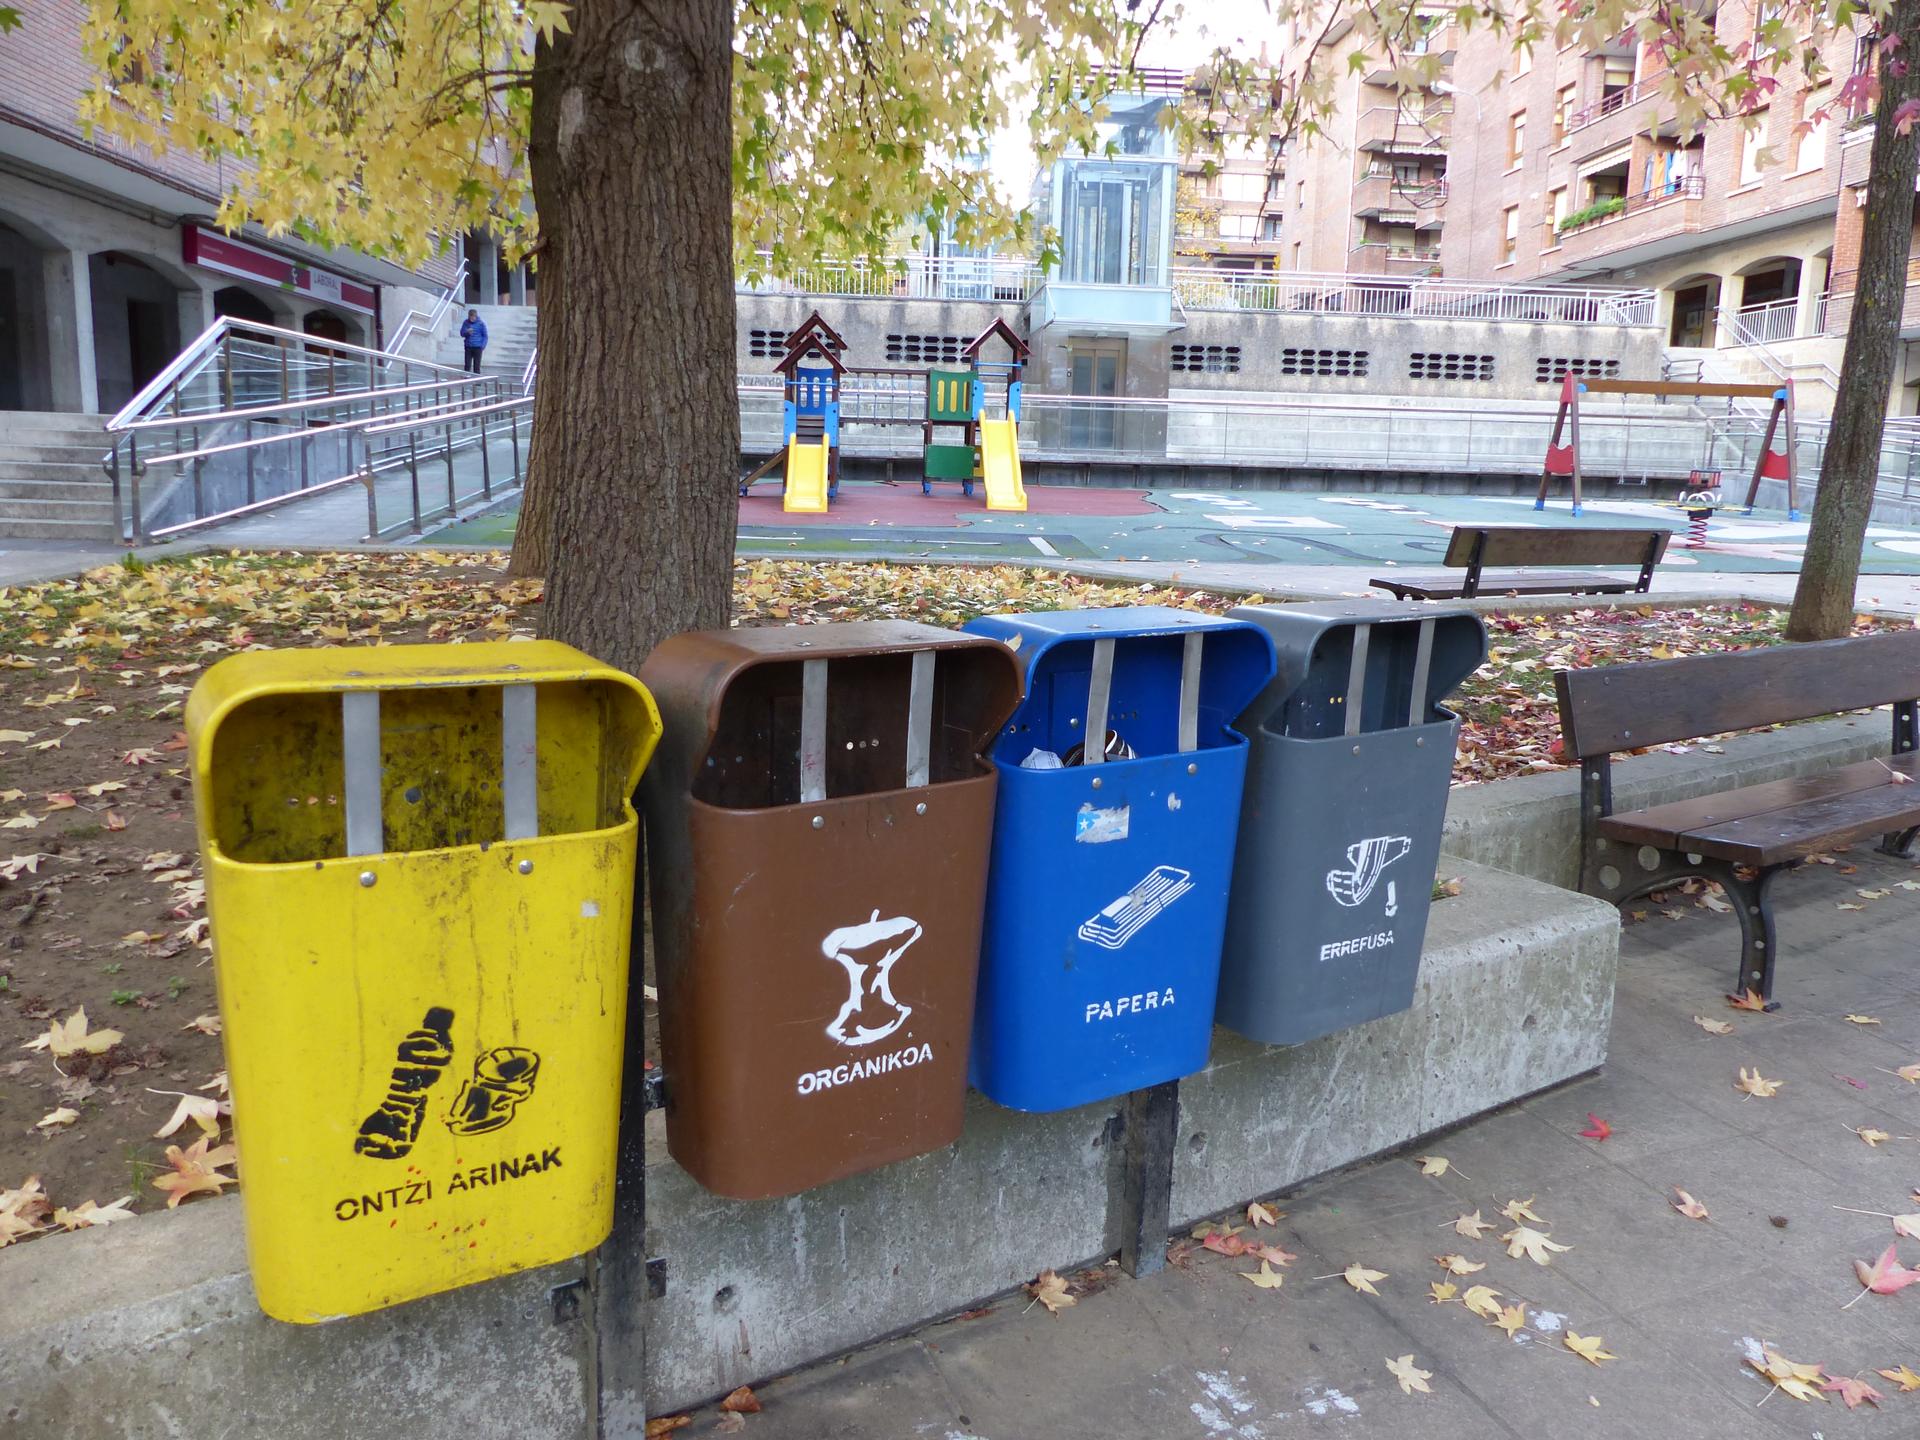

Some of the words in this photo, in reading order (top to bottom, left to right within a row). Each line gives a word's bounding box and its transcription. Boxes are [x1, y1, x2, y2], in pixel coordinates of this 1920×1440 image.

[1320, 930, 1394, 961] ERREFUSA
[1086, 987, 1175, 1023] PAPERA
[797, 1043, 933, 1094] ORGANIKOA
[335, 1180, 432, 1221] ONTZI
[448, 1147, 563, 1195] ARINAK
